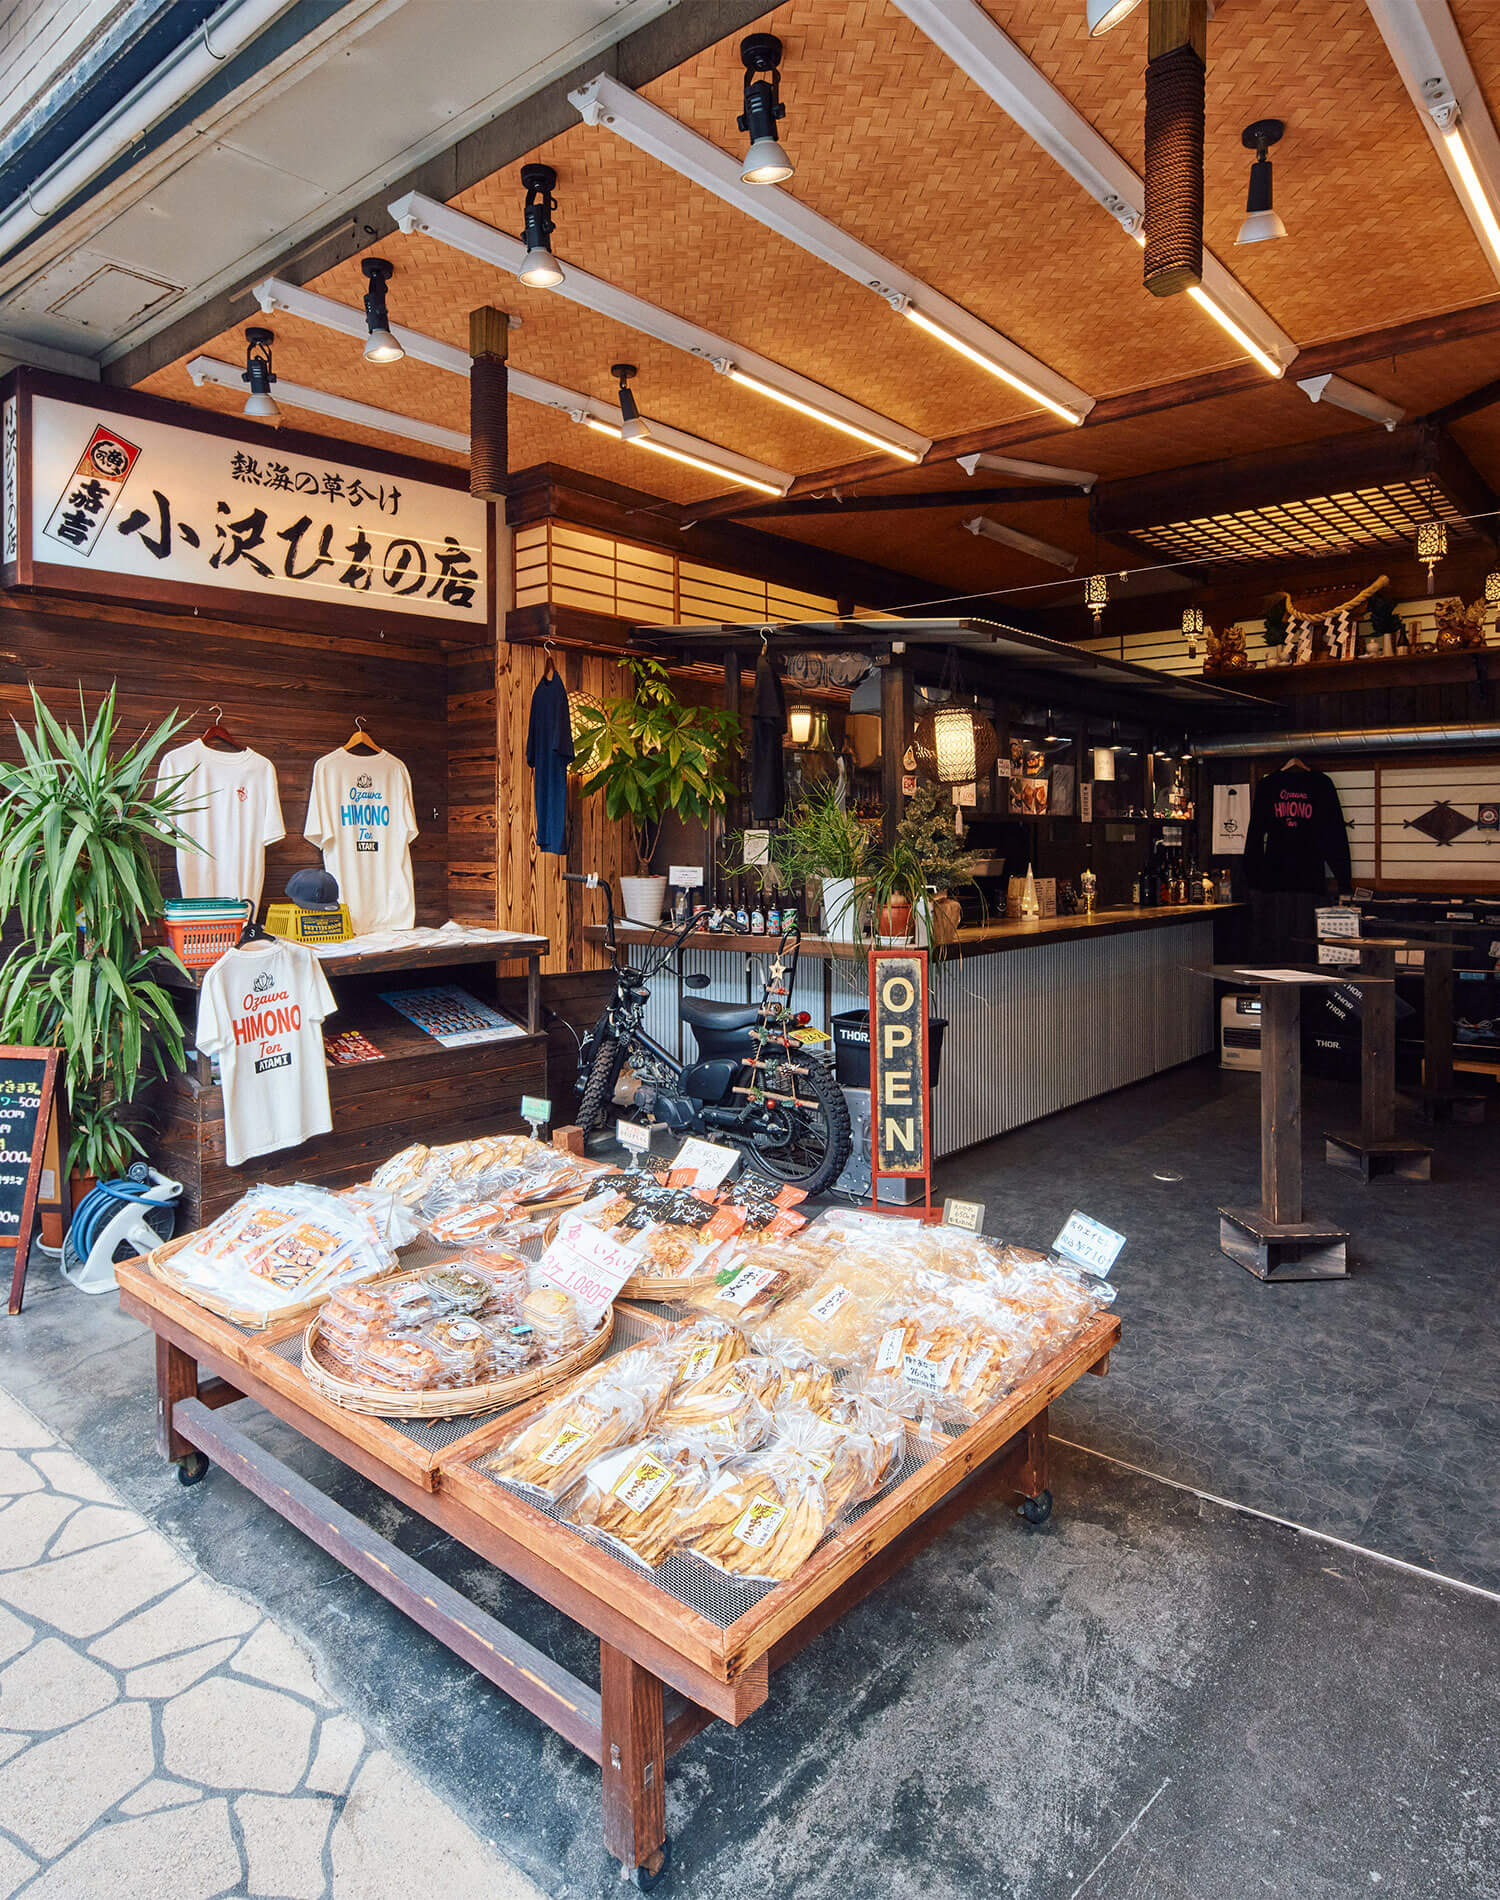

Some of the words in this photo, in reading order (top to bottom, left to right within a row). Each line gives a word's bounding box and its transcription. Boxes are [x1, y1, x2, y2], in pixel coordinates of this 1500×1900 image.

[230, 451, 401, 515] 熱海の草分け
[117, 490, 479, 608] 小沢ひもの店
[349, 787, 382, 802] Ozawa
[340, 804, 390, 827] HIMONO
[243, 990, 290, 1012] Ozawa
[232, 1004, 301, 1046] HIMONO
[259, 1041, 283, 1059] Ten
[259, 1054, 289, 1071] ATAMI
[882, 977, 915, 1152] OPEN
